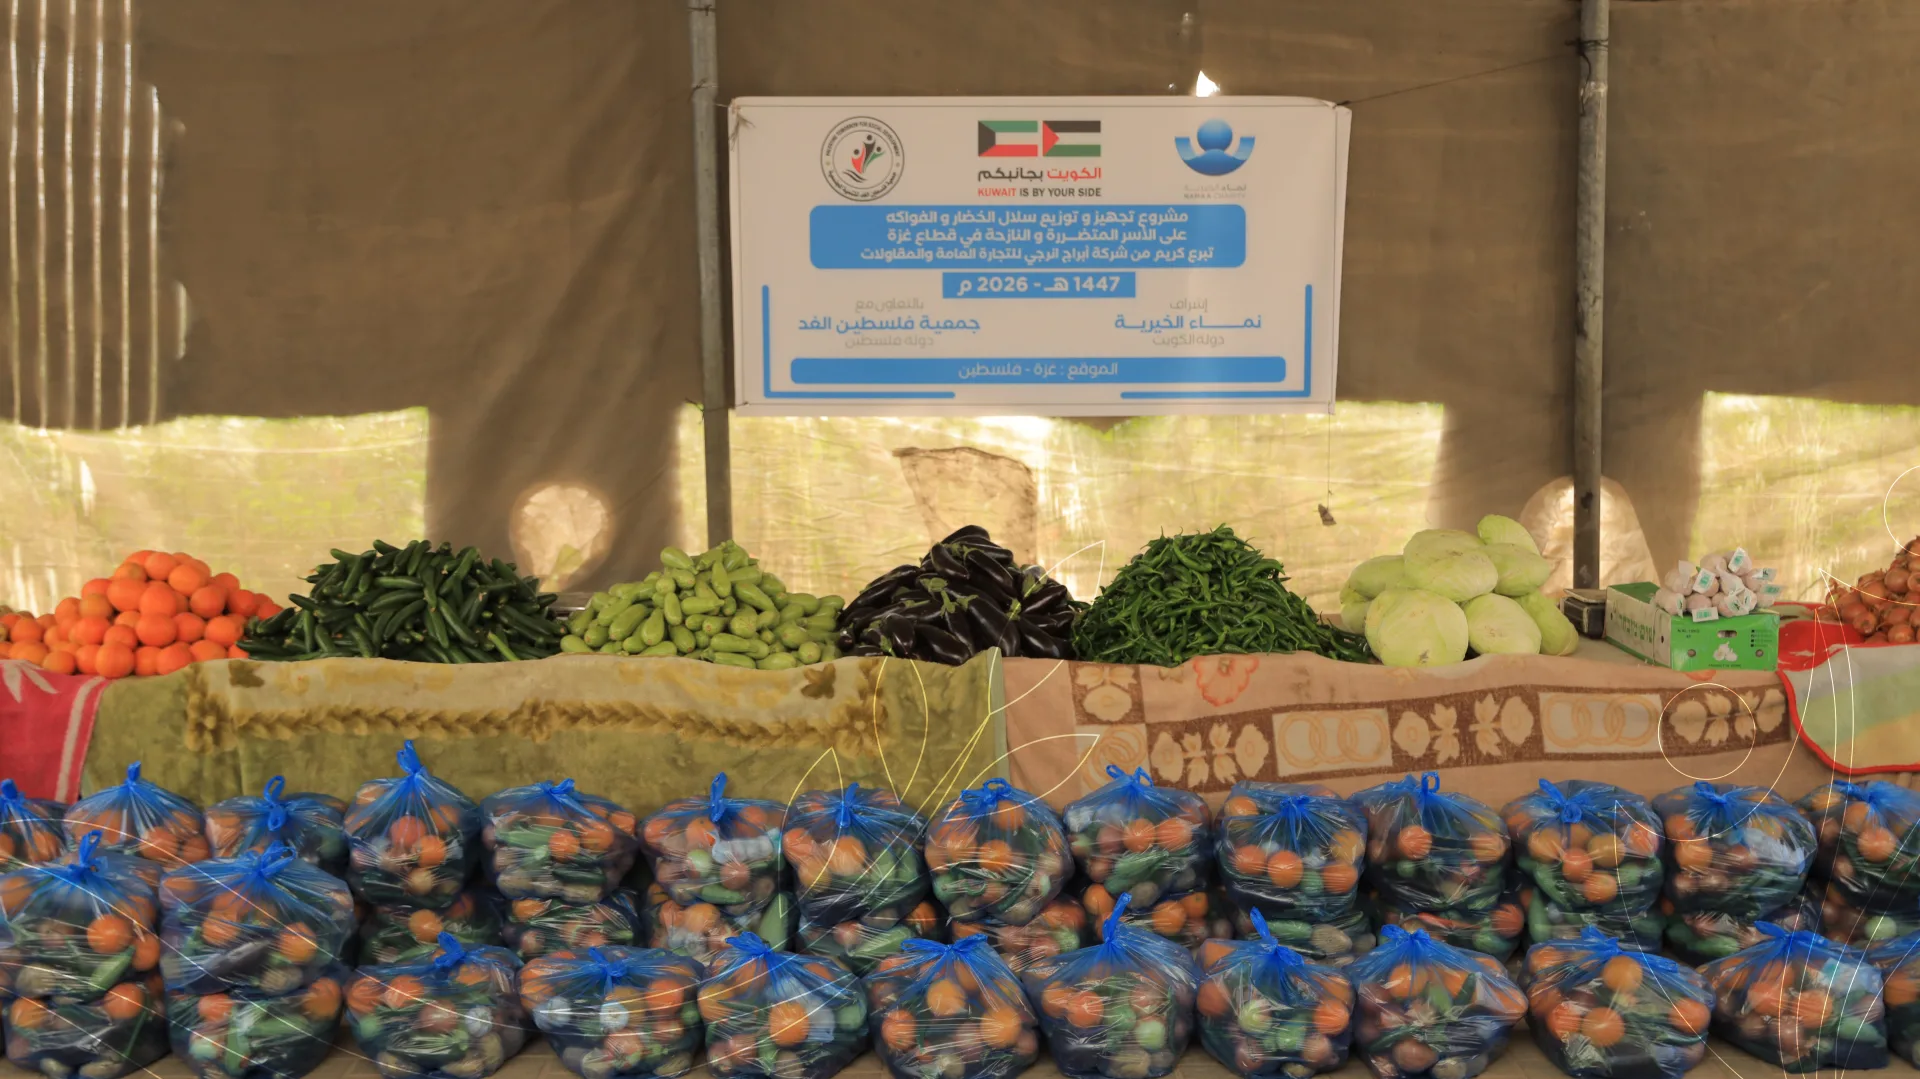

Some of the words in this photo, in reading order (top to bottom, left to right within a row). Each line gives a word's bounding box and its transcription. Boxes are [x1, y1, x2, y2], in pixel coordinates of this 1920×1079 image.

[978, 167, 1043, 182] بجانبكم
[1047, 167, 1102, 182] الكويت
[978, 188, 1016, 197] KUWAIT
[1020, 188, 1029, 197] IS
[1033, 188, 1045, 197] BY
[1048, 188, 1075, 197] YOUR
[1078, 188, 1102, 197] SIDE
[886, 210, 937, 226] الفواكه
[940, 213, 949, 226] و
[952, 209, 995, 226] الخضار
[998, 210, 1036, 226] سلال
[1040, 210, 1079, 228] توزيع
[1082, 213, 1091, 226] و
[1094, 209, 1134, 226] تجهيز
[1138, 208, 1188, 227] مشروع
[887, 228, 912, 244] غزة
[915, 228, 956, 245] قطاع
[960, 229, 982, 247] في
[985, 228, 1030, 244] النازحة
[1034, 230, 1043, 244] و
[1121, 226, 1156, 244] الأسر
[1159, 228, 1187, 244] على
[860, 248, 933, 262] والمقاولات
[936, 248, 976, 259] العامة
[979, 248, 1021, 262] للتجارة
[1024, 248, 1058, 265] الرجي
[1062, 246, 1089, 262] أبراج
[1092, 245, 1128, 261] شركة
[1130, 248, 1150, 261] من
[1154, 247, 1184, 262] كريم
[1188, 247, 1214, 262] تبرع
[957, 279, 972, 296] م
[977, 276, 1028, 292] 2026
[1073, 276, 1120, 292] 1447
[798, 316, 831, 330] الغد
[836, 316, 914, 334] فلسطين
[919, 315, 980, 334] جمعية
[958, 362, 1022, 379] فلسطين
[1033, 362, 1057, 378] غزة
[1067, 362, 1118, 380] الموقع
